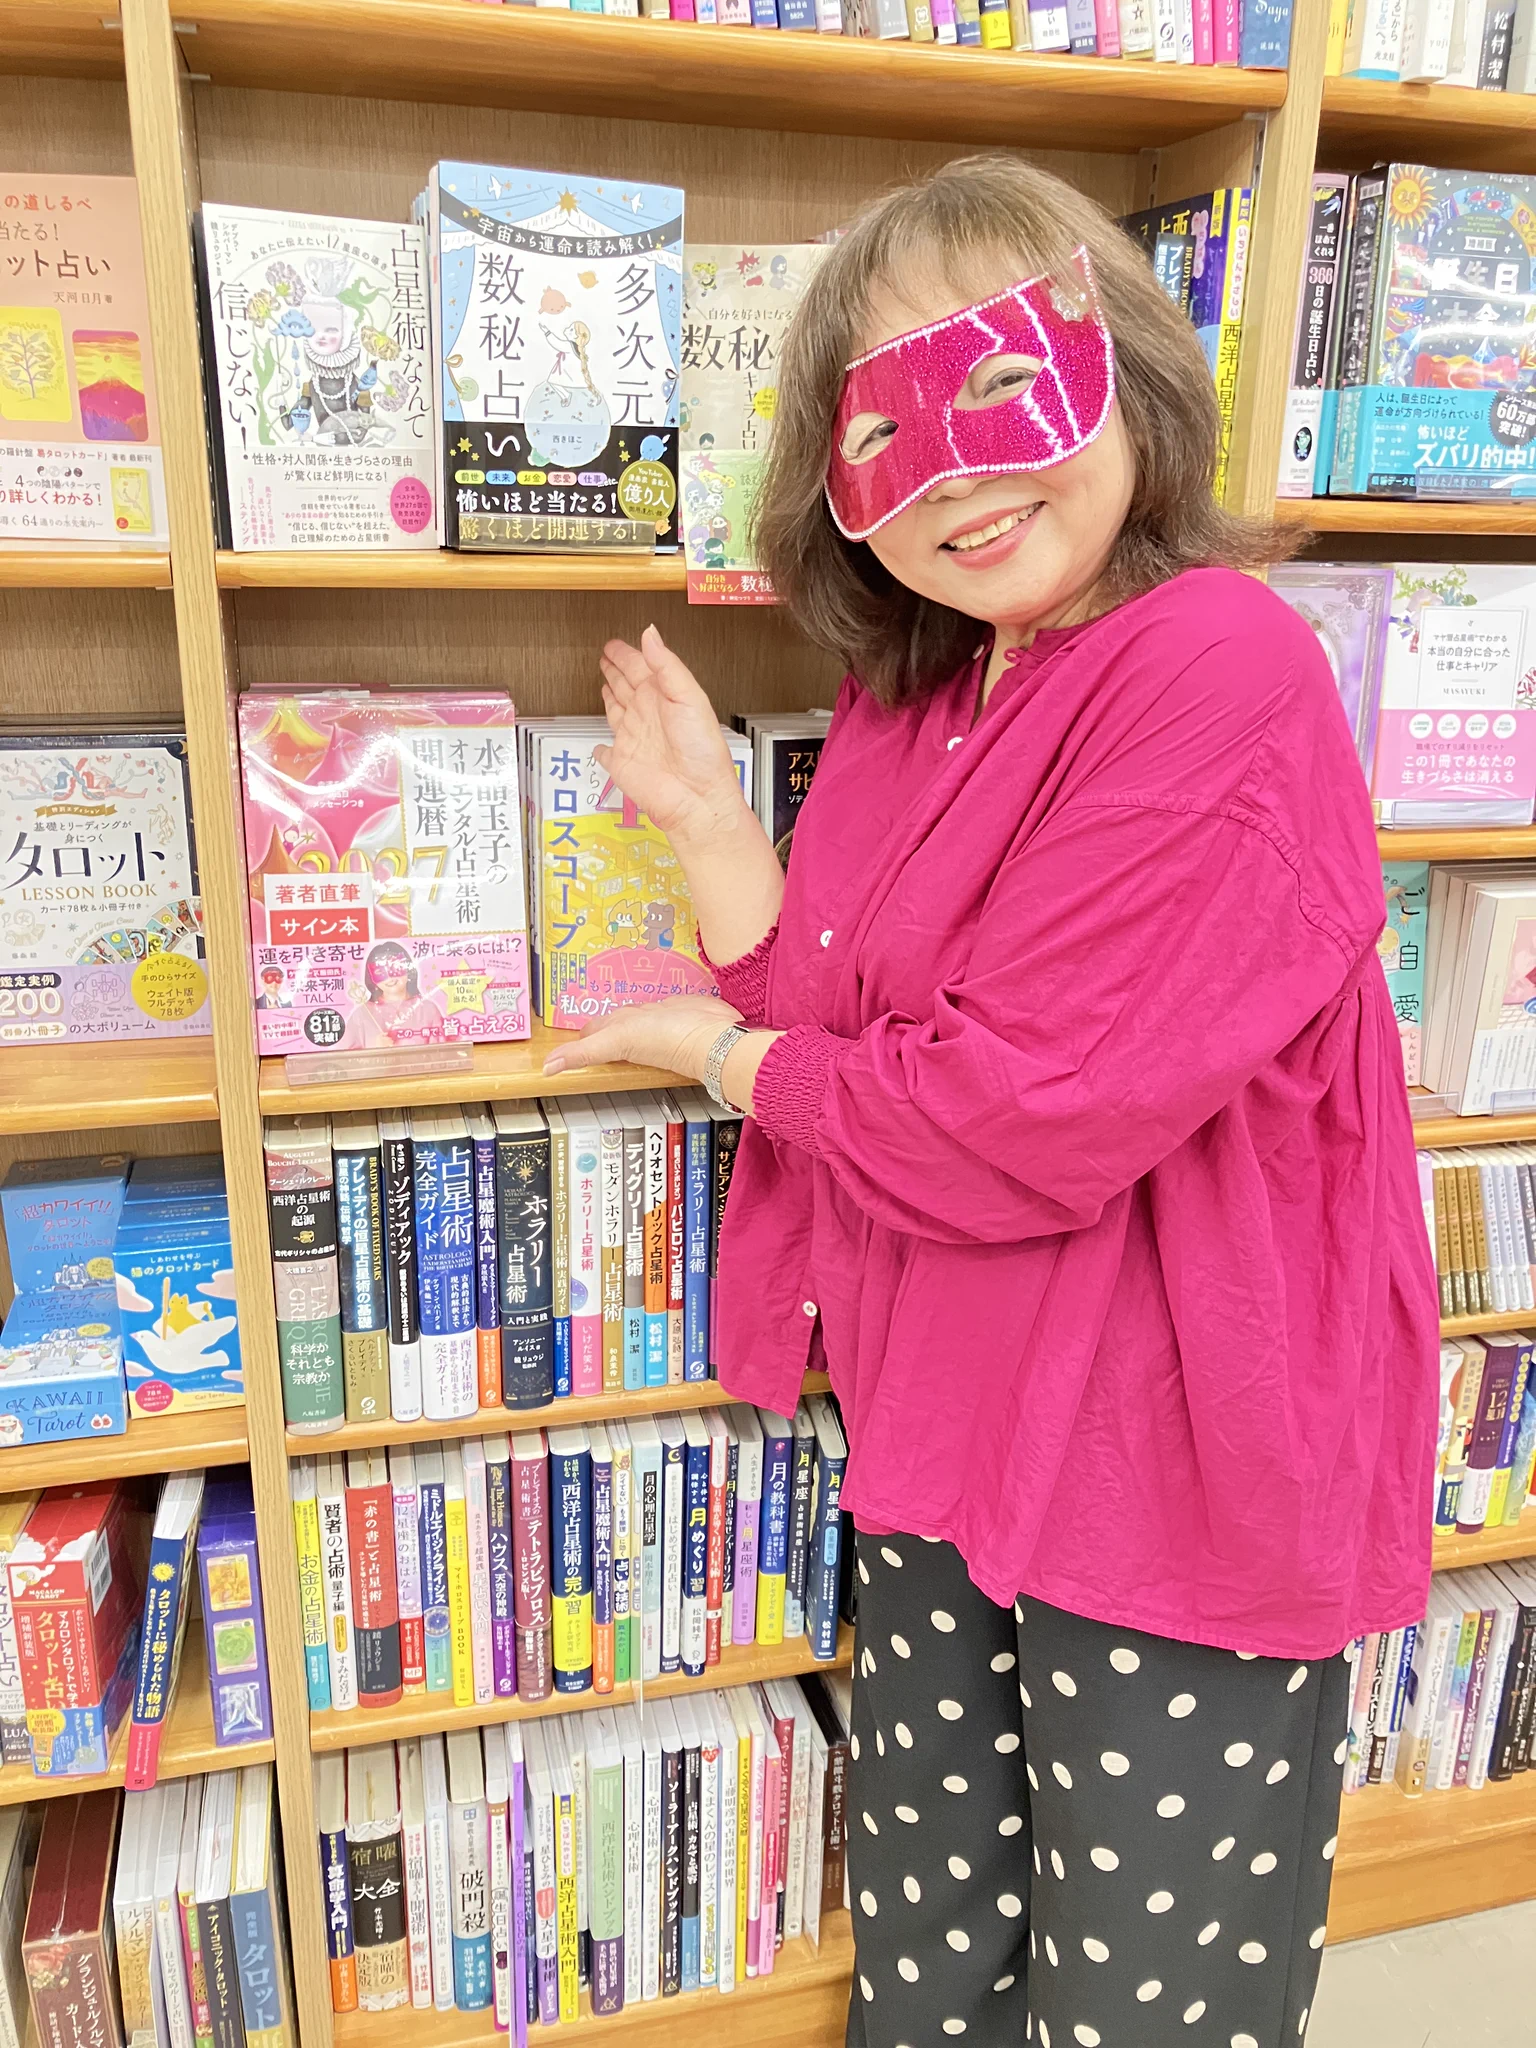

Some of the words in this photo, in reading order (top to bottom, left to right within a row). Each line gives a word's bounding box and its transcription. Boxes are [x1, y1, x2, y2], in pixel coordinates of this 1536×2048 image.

[477, 217, 654, 256] 宇宙から運命を読み解く!
[1314, 246, 1334, 257] くれる
[392, 229, 431, 439] 占星術なんて
[612, 263, 657, 426] 多次元
[681, 325, 783, 372] 数秘
[213, 279, 257, 461] 信じない!
[478, 252, 526, 458] 数秘占い
[1374, 406, 1484, 420] 運命が方向づけられている!
[1376, 392, 1458, 405] 人は、誕生日によって
[1417, 424, 1470, 441] 怖いほど
[1498, 420, 1527, 438] 突破!
[252, 454, 412, 467] 性格・対人関係・生きづらさの理由
[638, 467, 663, 477] YouTuber
[1413, 442, 1535, 471] ズバリ的中!
[285, 471, 387, 482] が驚くほど鮮明になる!
[461, 473, 479, 482] 前世
[492, 473, 510, 482] 未来
[524, 474, 541, 483] お金
[553, 474, 571, 483] 恋愛
[584, 475, 602, 484] 仕事
[456, 489, 617, 514] 怖いほど当たる!
[623, 484, 670, 509] 億り人
[291, 534, 390, 543] 自己理解のための占星術書
[460, 517, 638, 541] 驚くほど開運する!
[1427, 647, 1511, 658] 本当の自分に合った
[1436, 660, 1498, 671] 仕事とキャリア
[1401, 769, 1515, 784] 生きづらさは消える
[1404, 755, 1516, 767] この1冊であなたの
[34, 821, 132, 832] 基礎とリーディングが
[64, 833, 104, 844] 身につく
[0, 832, 166, 891] タロット
[548, 748, 587, 950] ホロスコープ
[21, 885, 95, 902] LESSON
[103, 884, 158, 898] BOOK
[275, 883, 361, 905] 著者直筆
[279, 915, 360, 937] サイン本
[259, 945, 364, 965] 運を引き寄せ
[141, 972, 196, 982] 手のひらサイズ
[148, 998, 195, 1008] フルデッキ
[160, 1008, 184, 1016] 78枚
[303, 993, 334, 1004] TALK
[453, 995, 477, 1003] 当たる!
[69, 1020, 156, 1035] の大ボリューム
[310, 1015, 331, 1033] 81
[313, 1032, 338, 1043] 突破!
[269, 1175, 331, 1186] ブーシェ・ルクレール
[440, 1146, 473, 1248] 占星術
[272, 1191, 331, 1206] 西洋占星術
[297, 1205, 308, 1214] の
[415, 1151, 439, 1250] 完全ガイド
[478, 1166, 496, 1261] 占星魔術入門
[625, 1143, 643, 1277] ディグリー占星術
[649, 1132, 663, 1284] ヘリオセントリック占星術
[42, 1217, 92, 1231] タロット
[291, 1214, 315, 1226] 起源
[393, 1176, 412, 1266] ゾディアック
[555, 1191, 568, 1268] ホラリー占星術
[580, 1178, 593, 1271] ホラリー占星術
[690, 1168, 707, 1273] ホラリー占星術
[150, 1253, 202, 1264] しあわせを呼ぶ
[351, 1157, 373, 1329] ブレイディの恒星占星術の基礎
[423, 1249, 473, 1260] ASTROLOGY
[520, 1195, 548, 1288] ホラリー
[604, 1163, 623, 1323] モダンホラリー占星術
[671, 1204, 683, 1301] バビロン占星術
[131, 1259, 220, 1278] 猫のタロットカード
[507, 1243, 528, 1303] 占星術
[450, 1276, 460, 1328] 現代的解釈まで
[461, 1273, 470, 1326] 古典的技法から
[556, 1271, 566, 1313] 実践ガイド
[507, 1313, 549, 1325] 入門と実践
[286, 1356, 335, 1371] それとも
[290, 1343, 328, 1355] 科学か
[513, 1354, 544, 1364] 鏡リュウジ
[582, 1325, 593, 1373] いけだ笑み
[292, 1372, 330, 1385] 宗教か
[434, 1343, 449, 1407] 完全ガイド!
[460, 1339, 473, 1401] 西洋占星術の
[6, 1391, 104, 1414] KAWAII
[27, 1412, 86, 1436] Tarot
[521, 1466, 531, 1517] 占星術書
[531, 1462, 542, 1515] プトレマイオスの
[691, 1473, 699, 1504] 調律する
[794, 1450, 810, 1501] 月星座
[644, 1475, 656, 1543] 月の心理占星学
[769, 1462, 786, 1534] 月の教科書
[825, 1471, 841, 1522] 月星座
[324, 1504, 345, 1579] 賢者の占術
[595, 1484, 611, 1568] 占星魔術入門
[363, 1500, 383, 1602] 『赤の書』と占星術
[397, 1506, 412, 1600] 12星座のおはなし
[430, 1489, 446, 1604] ミドルエイジ・クライシス
[490, 1533, 509, 1571] ハウス
[689, 1508, 706, 1599] 月めぐり習
[527, 1520, 545, 1625] テトラビブロス
[301, 1554, 324, 1644] お金の占星術
[495, 1573, 507, 1616] 天空の神殿
[144, 1588, 171, 1719] タロットに秘められた物語
[351, 1843, 397, 1866] 宿曜
[667, 1781, 680, 1923] ソーラーアークハンドブック
[327, 1864, 348, 1931] 算命学入門
[353, 1877, 400, 1901] 大全
[460, 1869, 485, 1933] 破門殺
[559, 1877, 576, 1973] 西洋占星術入門
[242, 1943, 275, 2030] タロット
